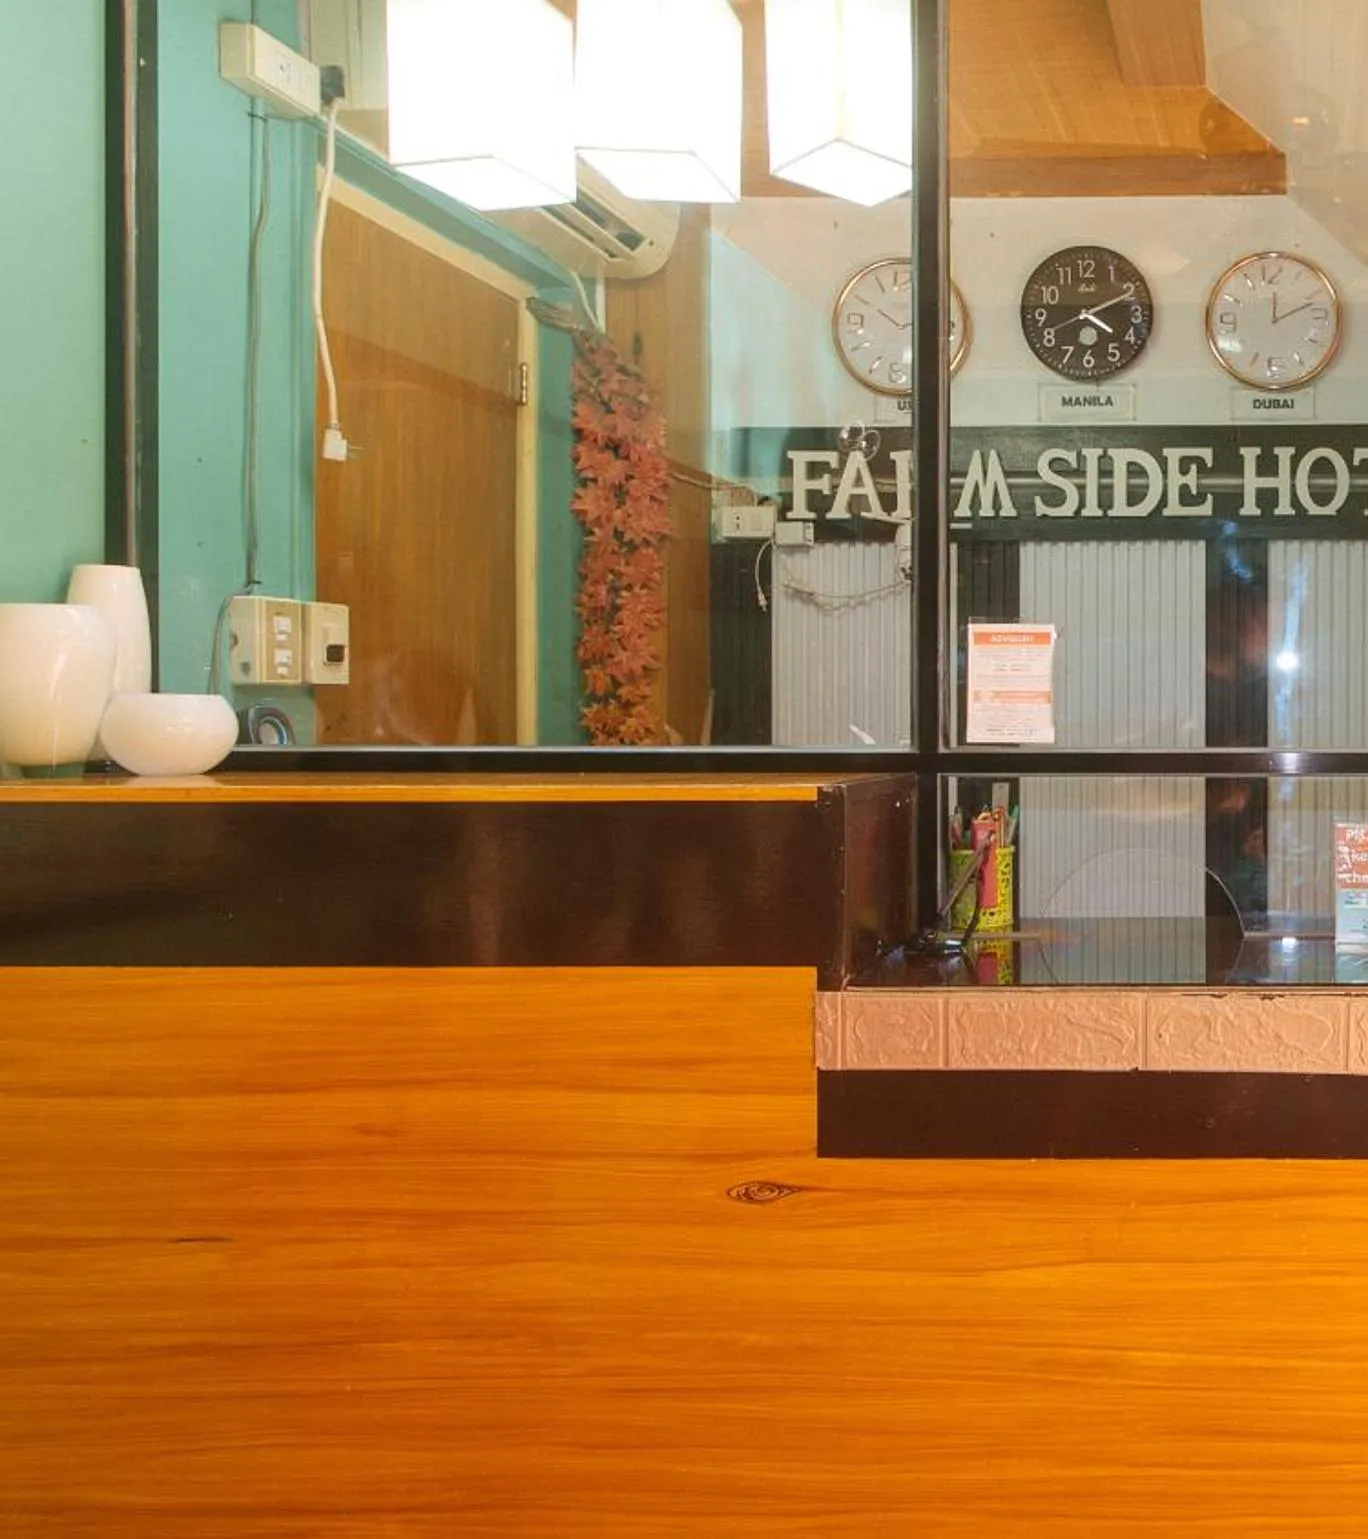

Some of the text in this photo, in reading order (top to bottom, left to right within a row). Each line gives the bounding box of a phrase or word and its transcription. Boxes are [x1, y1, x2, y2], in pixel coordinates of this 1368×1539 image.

[1056, 266, 1072, 285] 11
[1077, 260, 1096, 279] 12
[1108, 265, 1116, 283] 1
[1040, 286, 1060, 305] 10
[1035, 308, 1047, 327] 9
[1131, 305, 1143, 324] 3
[1043, 328, 1055, 347] 8
[1124, 326, 1136, 345] 4
[1061, 346, 1075, 364] 7
[1082, 350, 1096, 368] 6
[1108, 343, 1121, 362] 5
[1061, 395, 1114, 408] MANILA
[1253, 399, 1295, 409] DUBAI
[787, 449, 1018, 519] FAM
[1034, 447, 1214, 517] SIDE
